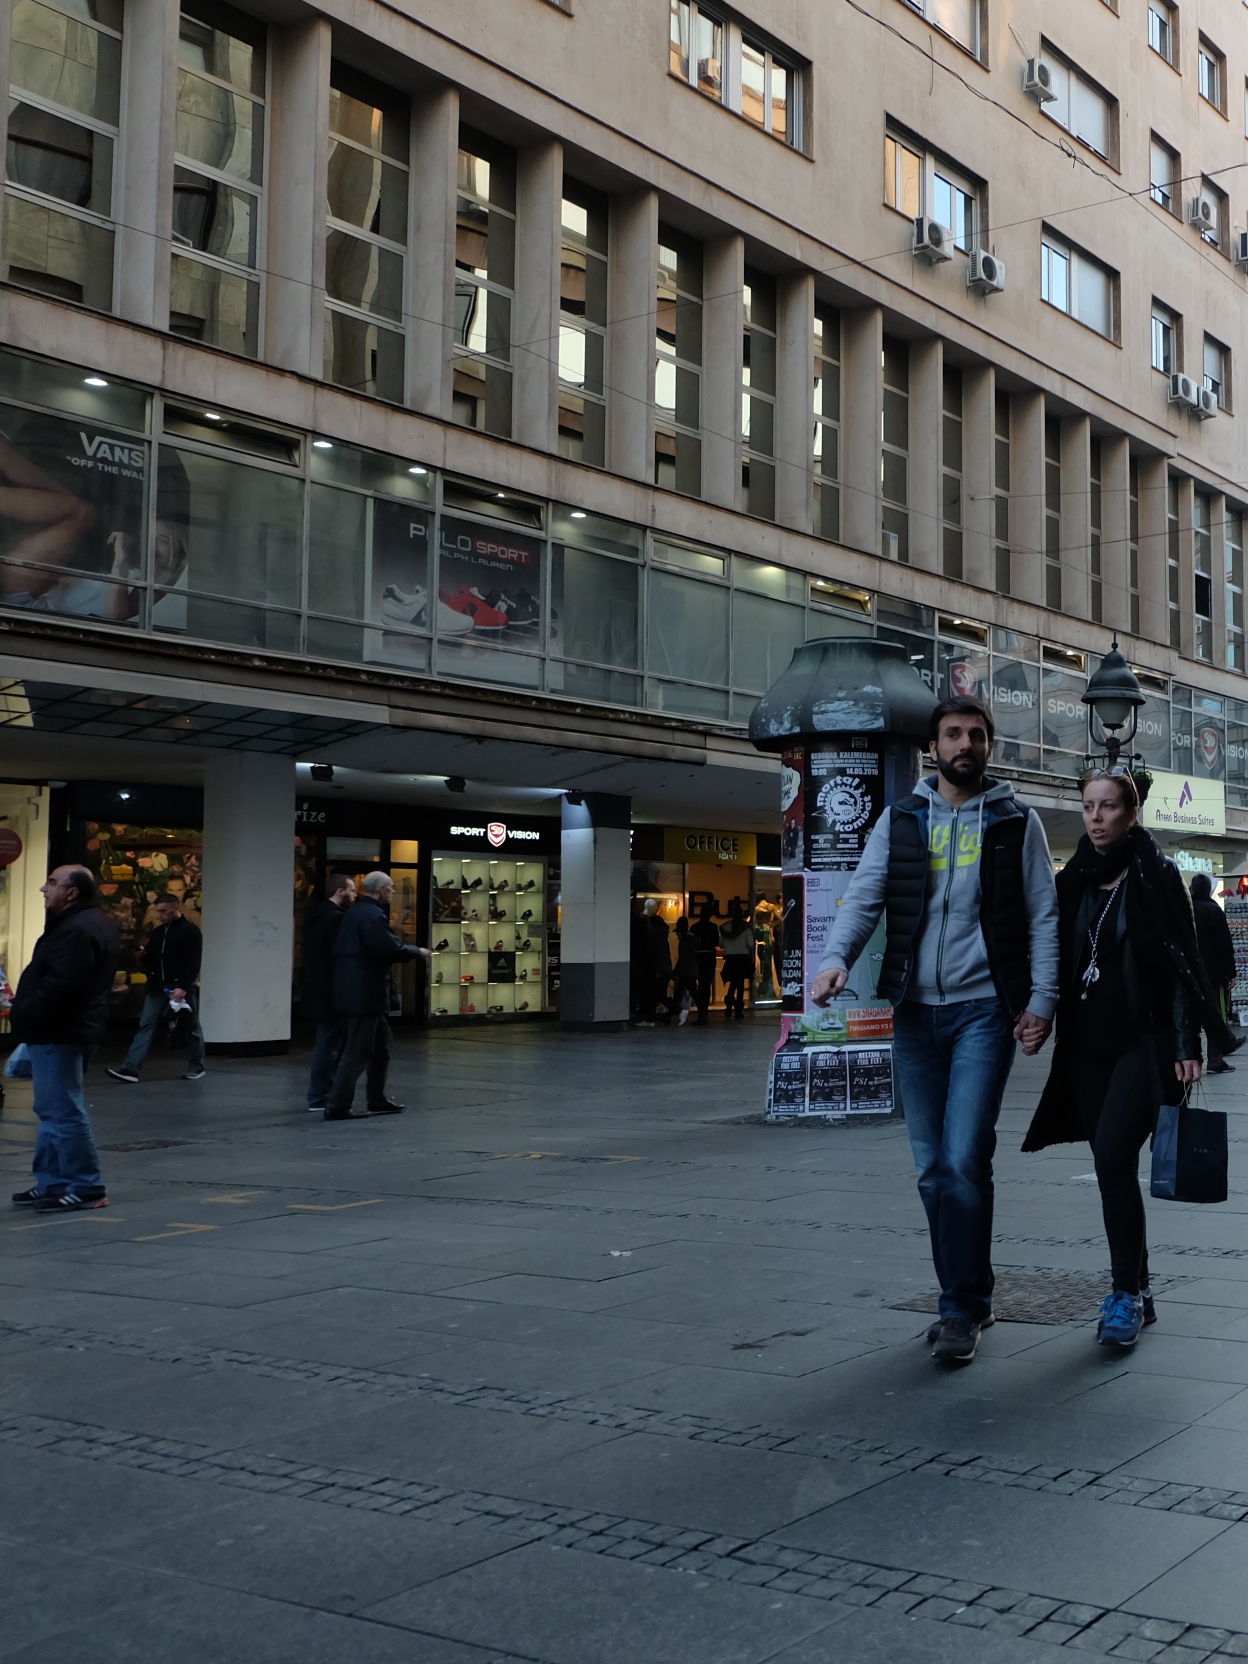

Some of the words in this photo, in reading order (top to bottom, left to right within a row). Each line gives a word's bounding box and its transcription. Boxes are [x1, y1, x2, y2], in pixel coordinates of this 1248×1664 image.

[80, 432, 145, 467] VANS
[97, 463, 119, 475] THE
[121, 468, 145, 480] WAL
[410, 523, 471, 551] PLO
[477, 541, 529, 563] SPORT
[440, 550, 469, 562] ALPH
[471, 556, 513, 571] LAUREN
[817, 775, 860, 807] mortal
[295, 801, 326, 823] rize
[834, 794, 873, 834] kombat
[450, 826, 486, 837] SPORT
[507, 830, 540, 840] VISION
[684, 834, 739, 853] OFFICE
[806, 924, 828, 933] Book
[806, 933, 824, 942] Fest
[853, 1077, 868, 1085] PSI
